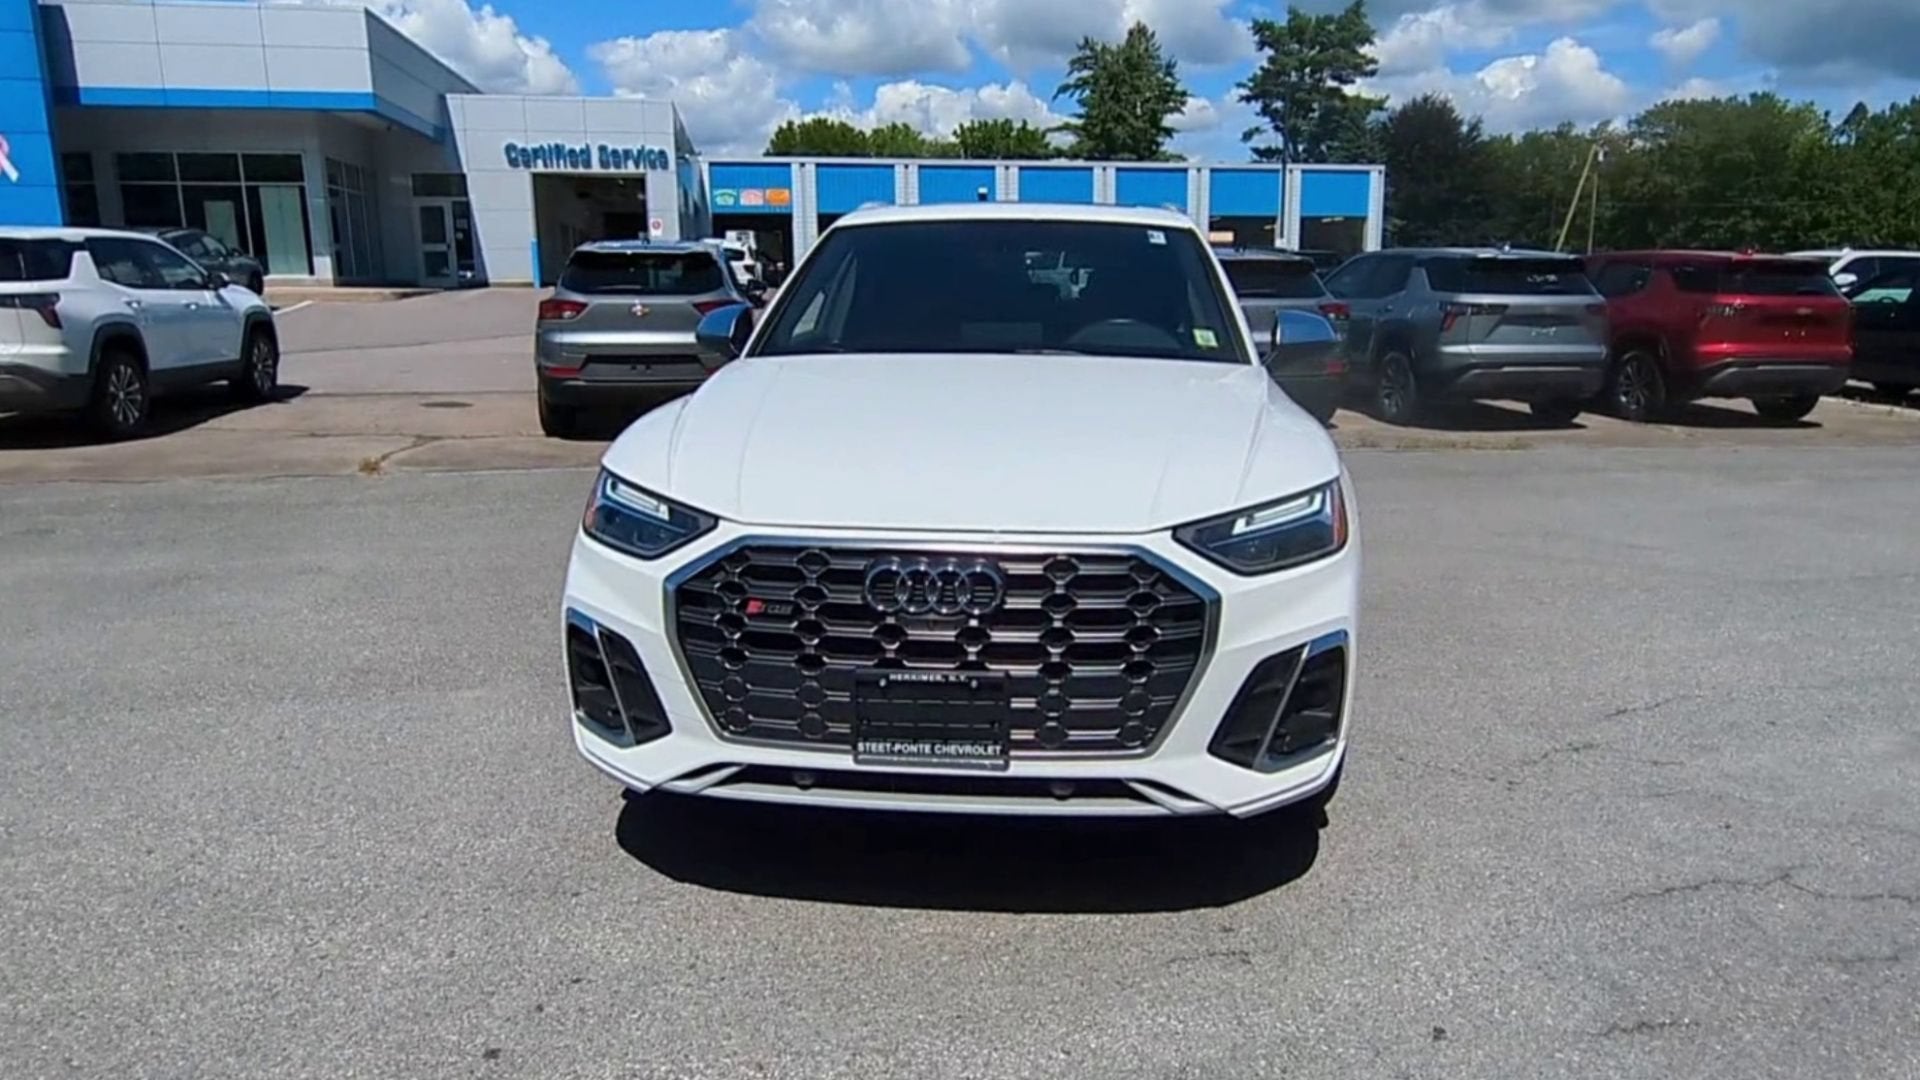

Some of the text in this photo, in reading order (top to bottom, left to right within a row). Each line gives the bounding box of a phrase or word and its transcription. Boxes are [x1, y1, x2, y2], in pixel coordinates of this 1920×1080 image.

[504, 142, 669, 170] Certified Service
[857, 742, 1002, 756] STEET-PONTE CHEVROLET
